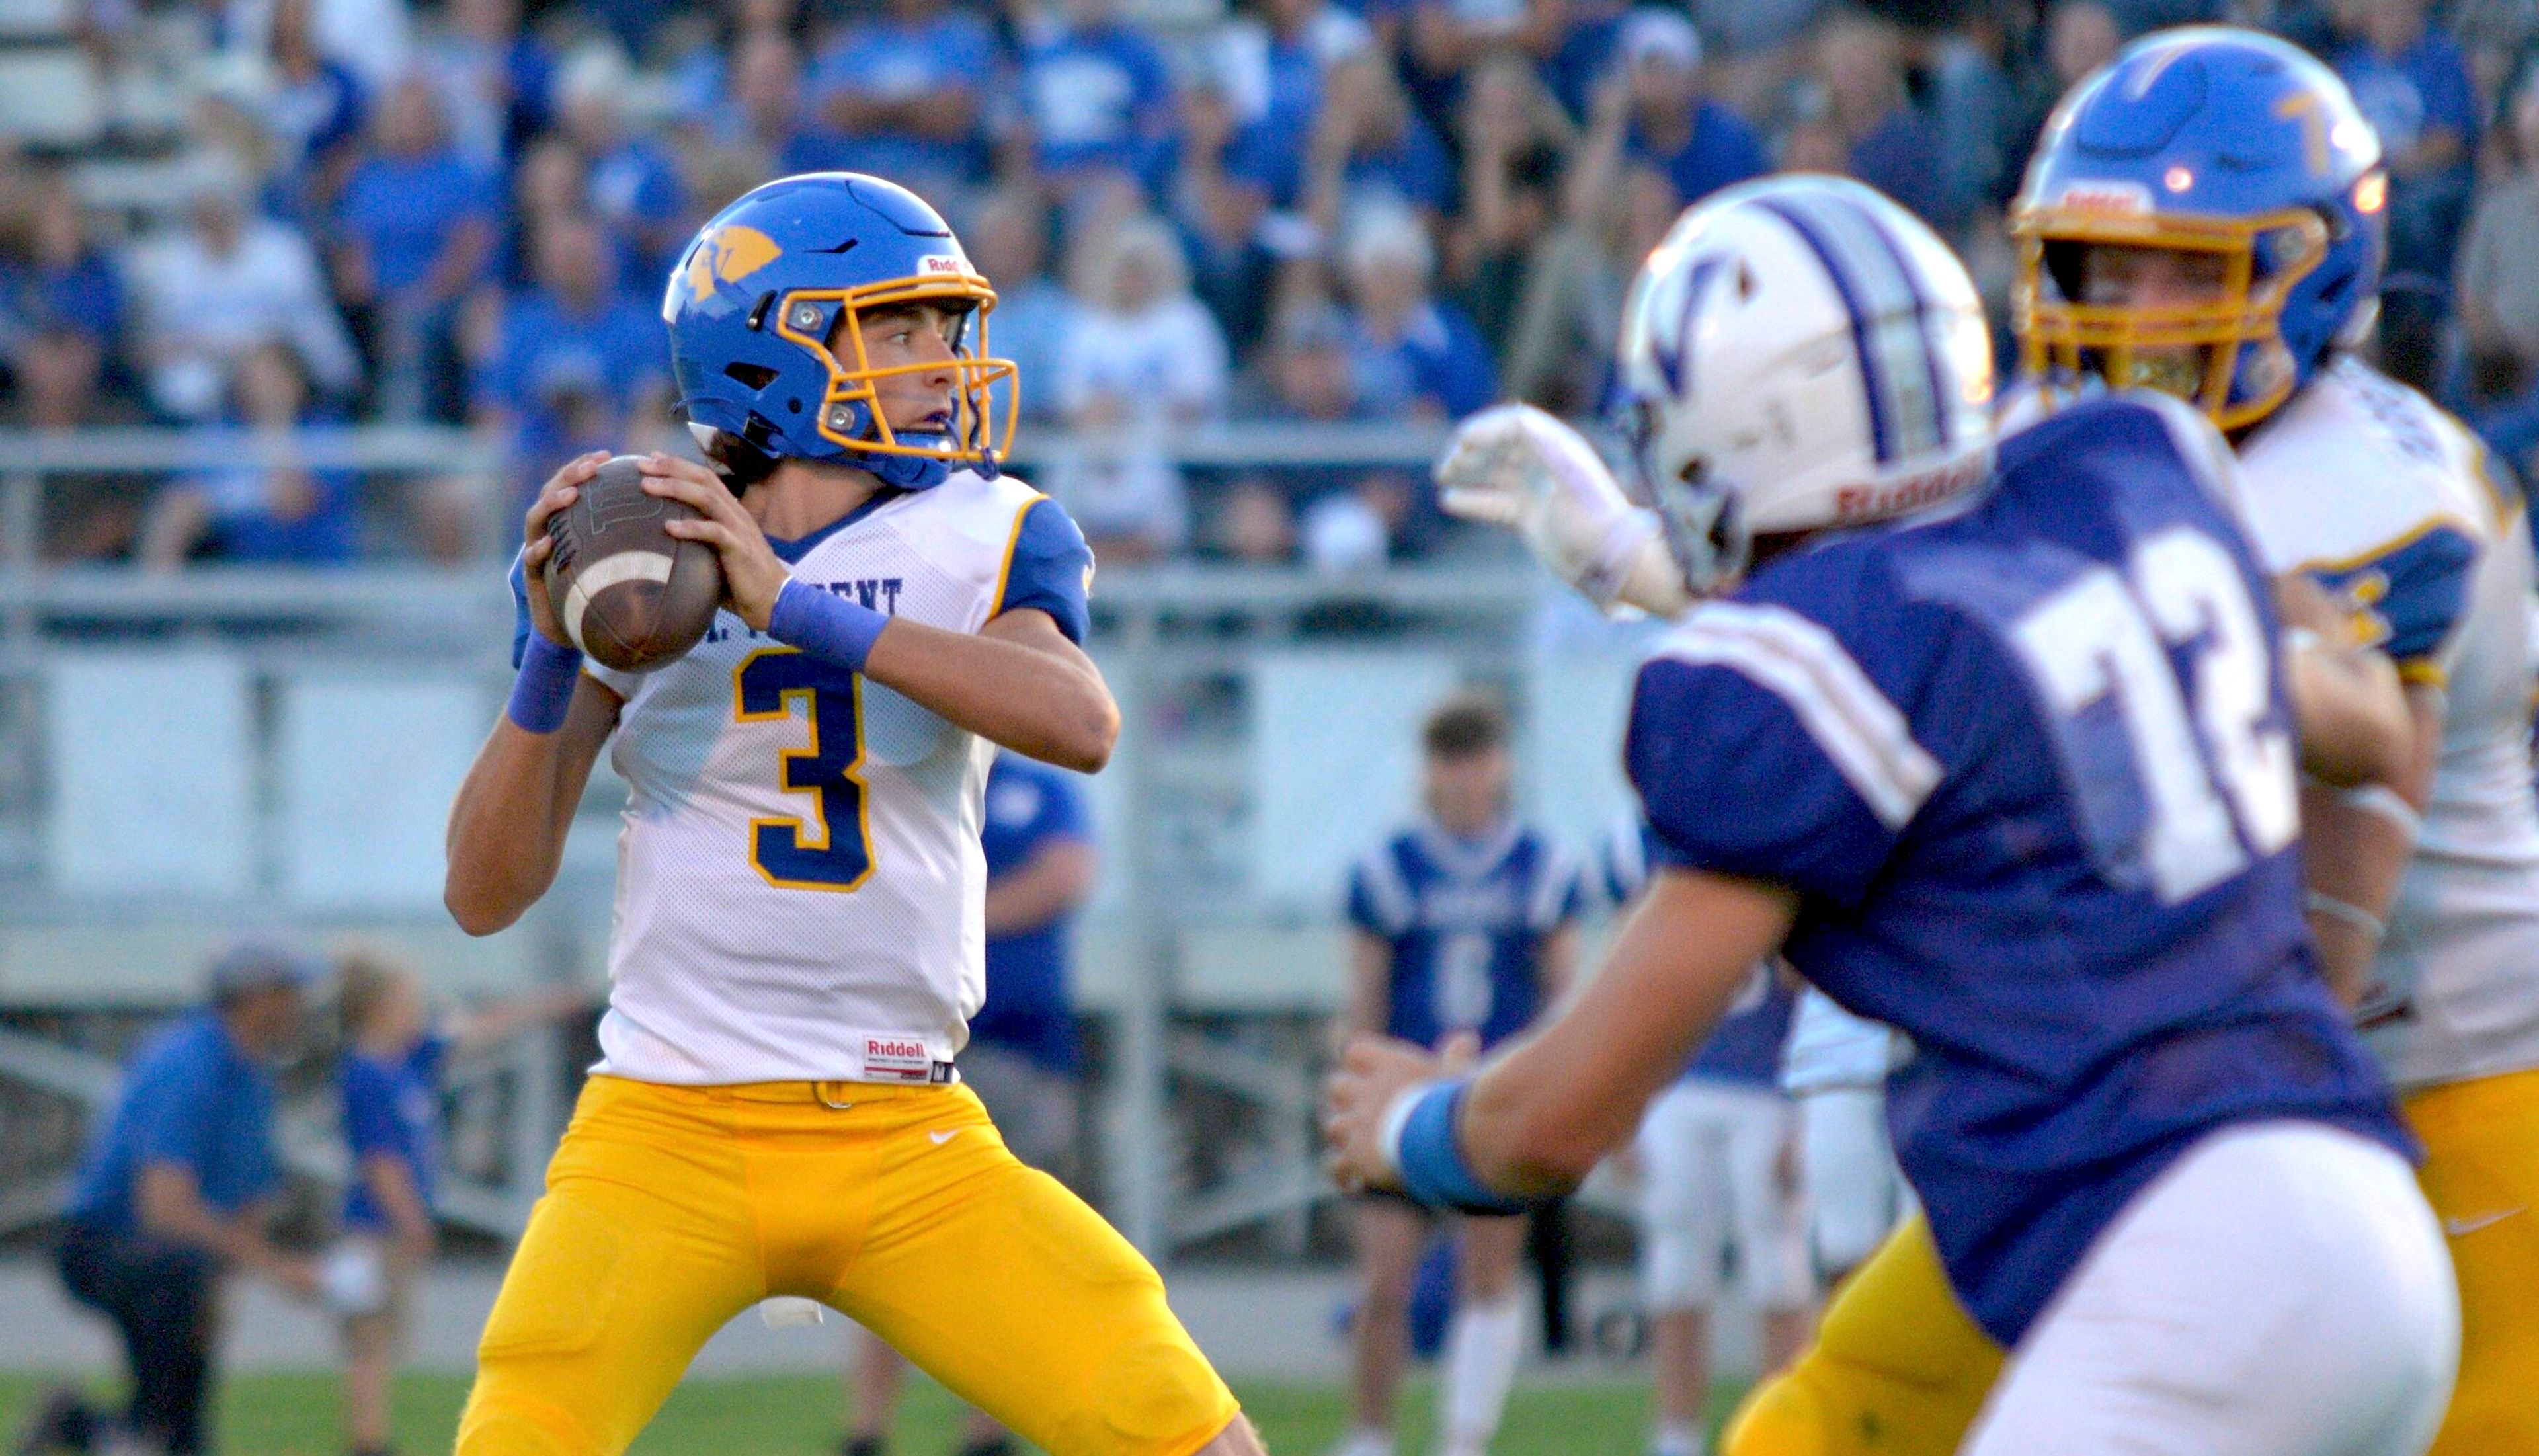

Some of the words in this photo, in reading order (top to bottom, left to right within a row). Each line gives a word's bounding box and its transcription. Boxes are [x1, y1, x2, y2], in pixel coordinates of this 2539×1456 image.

[733, 645, 877, 893] 3
[2017, 524, 2302, 905] 72
[868, 1040, 925, 1057] Riddell
